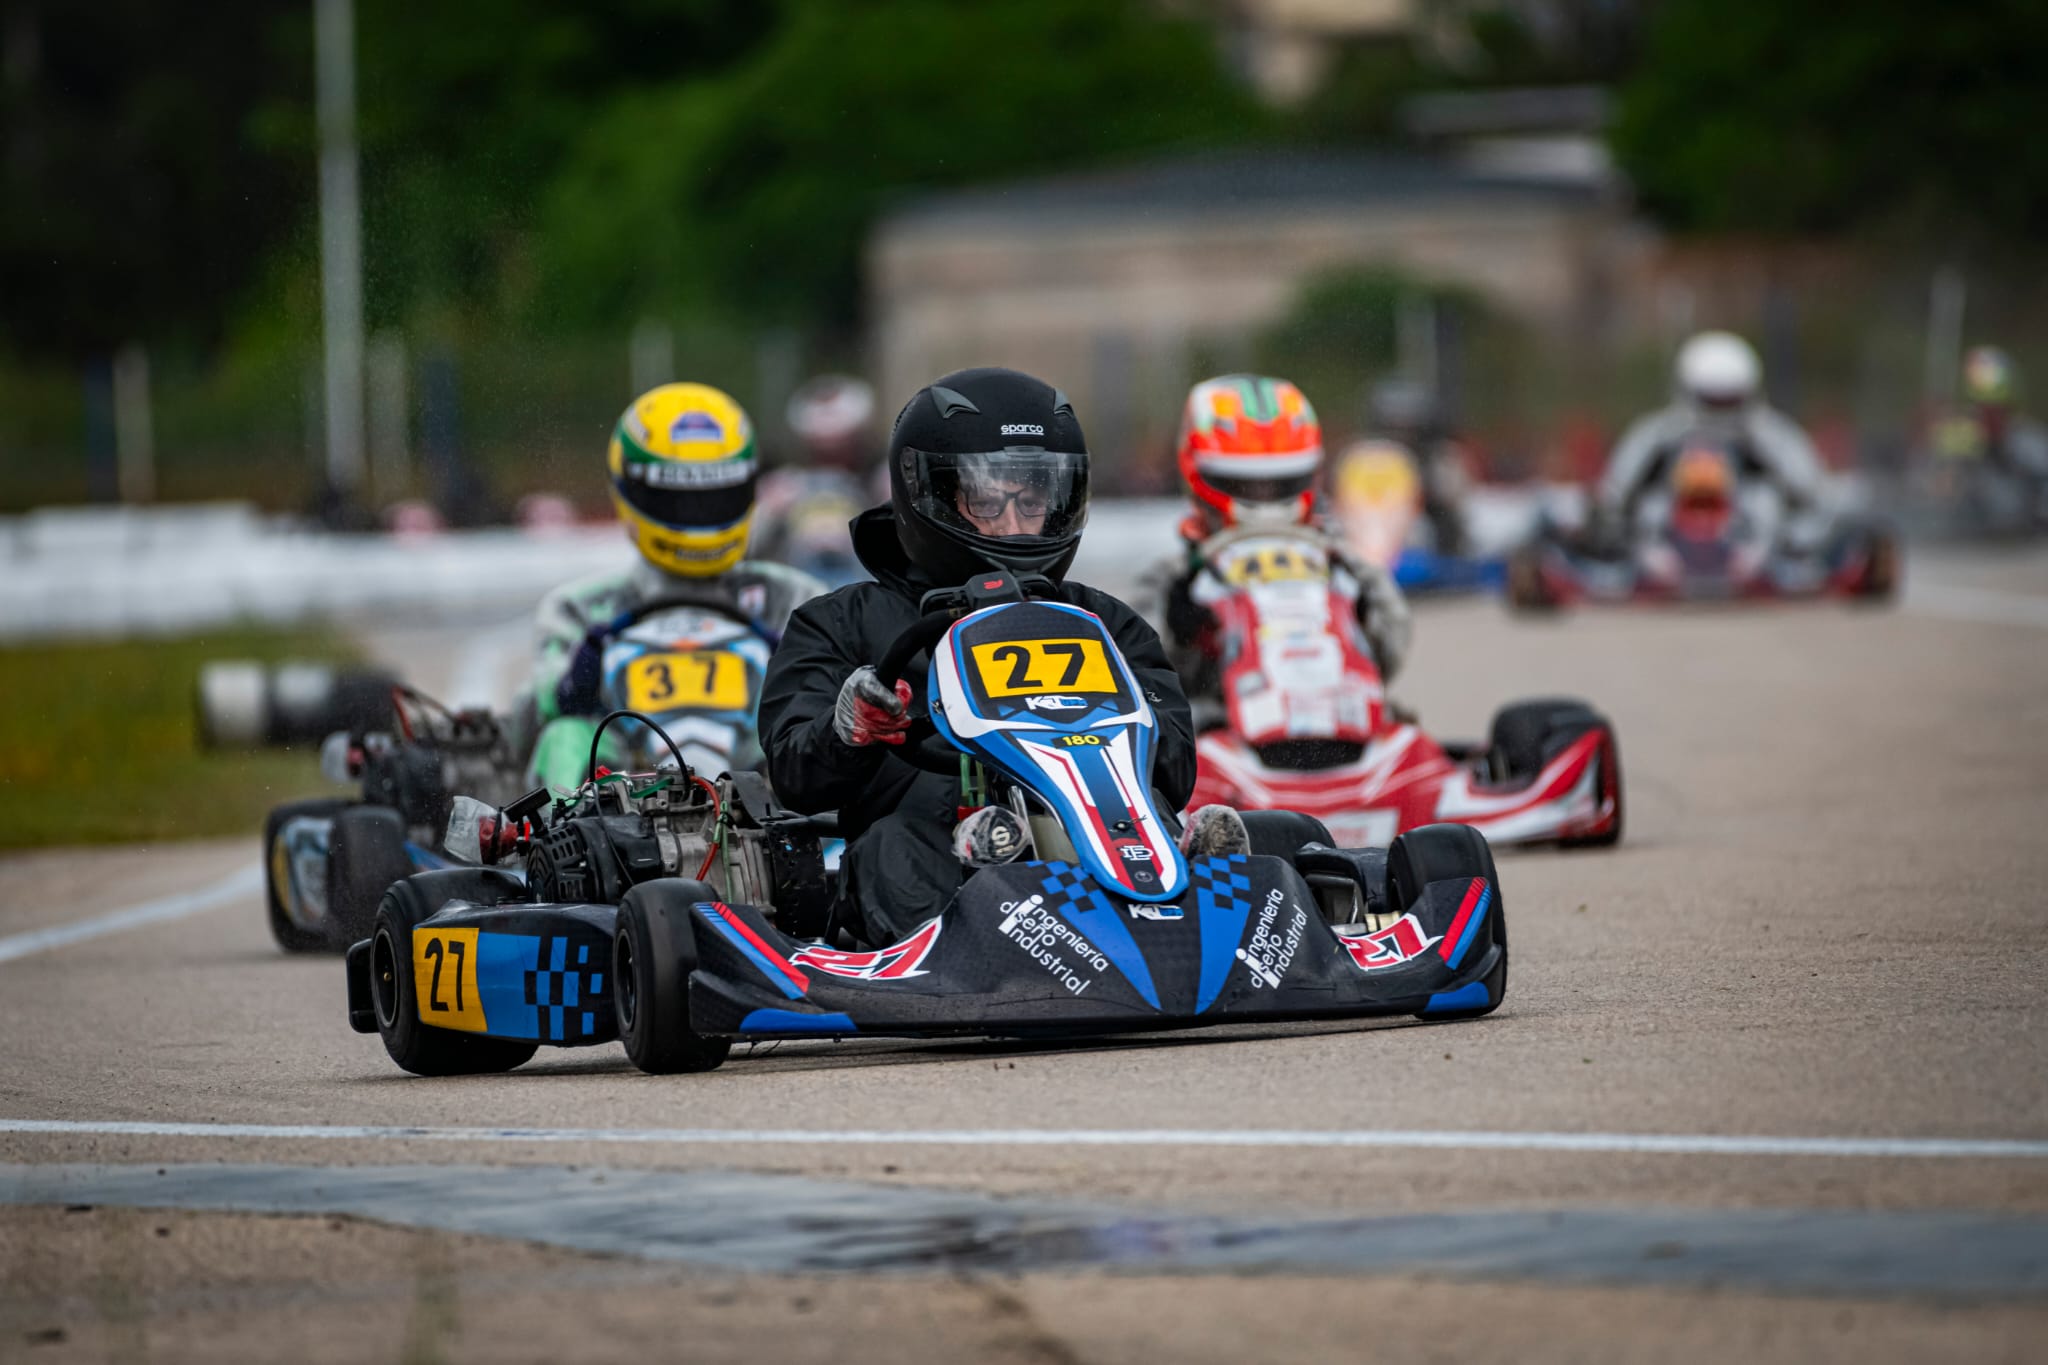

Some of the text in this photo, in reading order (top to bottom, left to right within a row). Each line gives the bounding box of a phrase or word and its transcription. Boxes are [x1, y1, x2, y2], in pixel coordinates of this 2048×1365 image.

[1001, 424, 1044, 435] sparco
[992, 642, 1086, 689] 27
[1062, 735, 1100, 746] 180
[424, 937, 466, 1013] 27
